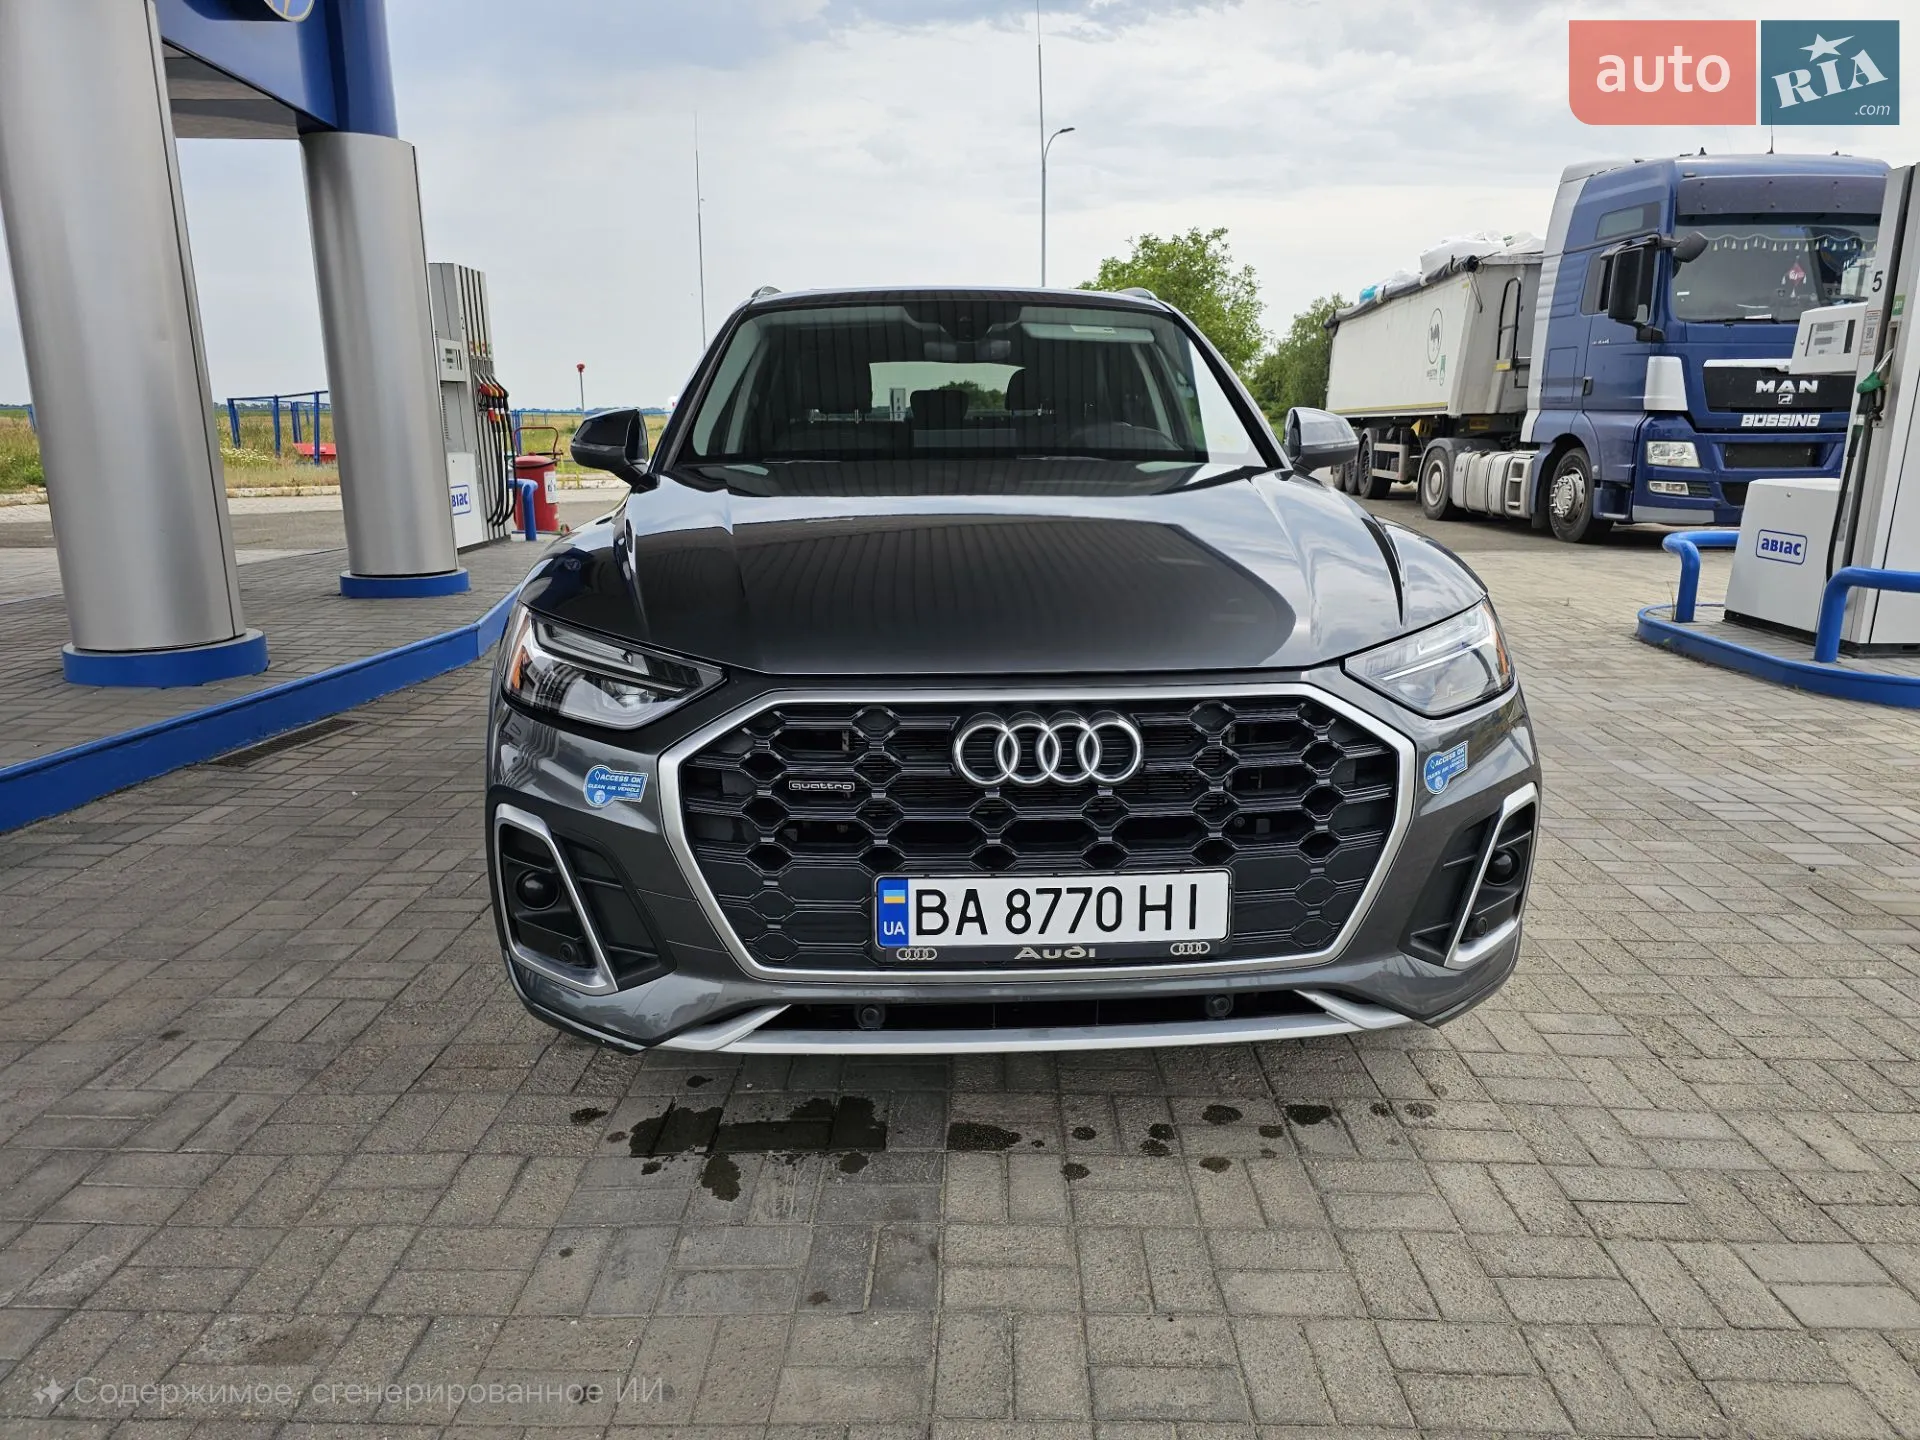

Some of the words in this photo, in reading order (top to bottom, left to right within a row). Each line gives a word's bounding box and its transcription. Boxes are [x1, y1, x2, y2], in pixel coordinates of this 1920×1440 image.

[1872, 270, 1884, 292] 5
[1755, 380, 1819, 393] MAN
[451, 492, 468, 507] віас
[600, 774, 629, 782] ACCESS
[631, 776, 643, 784] OK
[915, 888, 988, 936] BA
[1004, 886, 1123, 935] 8770
[1138, 883, 1198, 931] HI
[883, 921, 906, 936] UA
[1014, 945, 1096, 960] Audi
